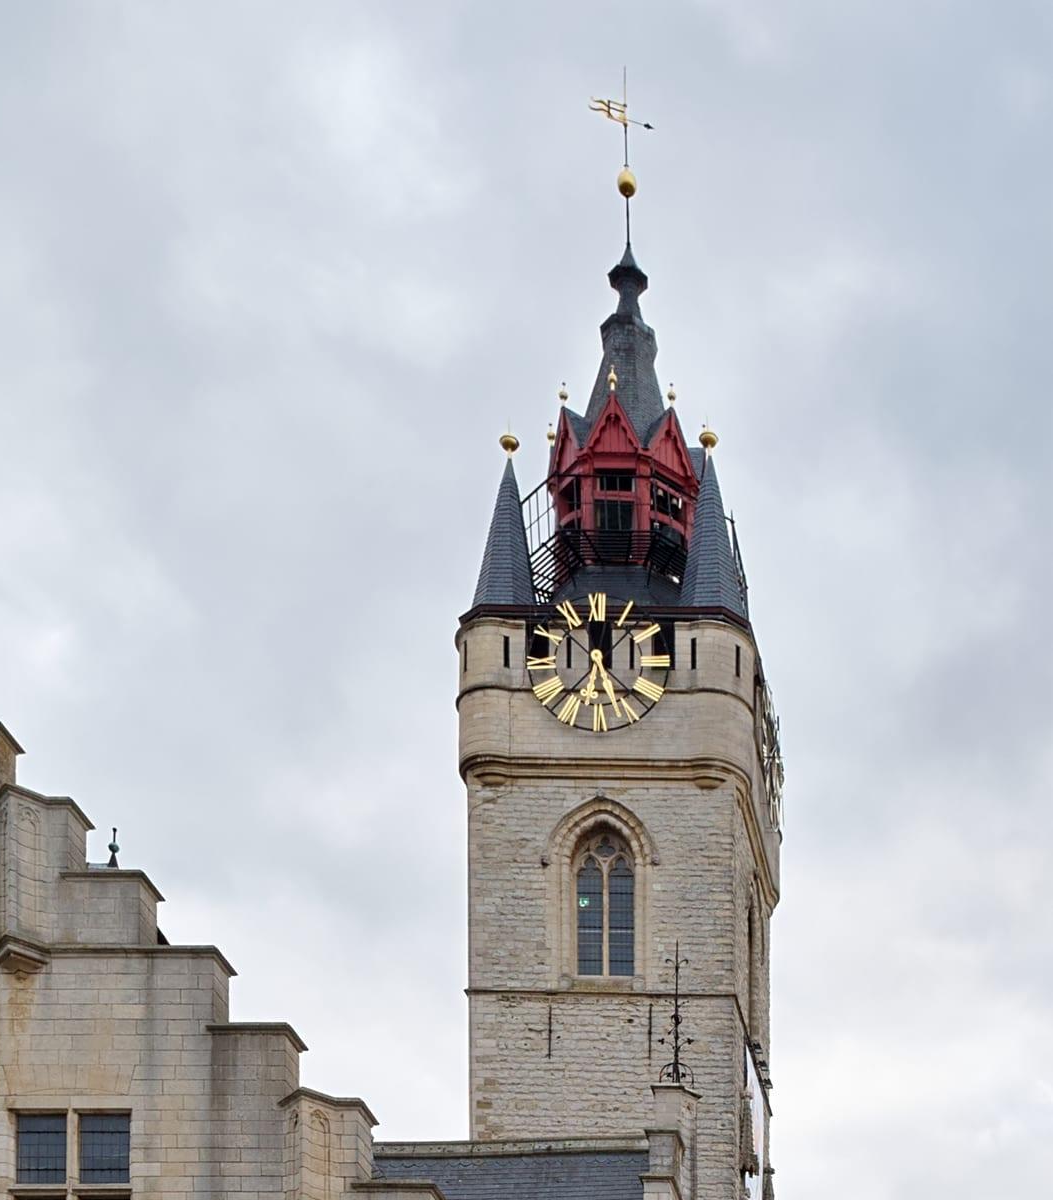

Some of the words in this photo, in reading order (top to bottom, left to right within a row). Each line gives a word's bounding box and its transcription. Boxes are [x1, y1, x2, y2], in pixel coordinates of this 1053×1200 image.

[556, 600, 582, 630] XI
[588, 592, 606, 622] XII
[617, 600, 634, 626] I
[533, 624, 563, 645] X
[633, 623, 661, 643] II
[526, 655, 556, 670] IX
[640, 655, 670, 667] III
[532, 676, 564, 705] VIII
[557, 694, 581, 726] VII
[593, 704, 608, 731] VI
[620, 697, 640, 724] V
